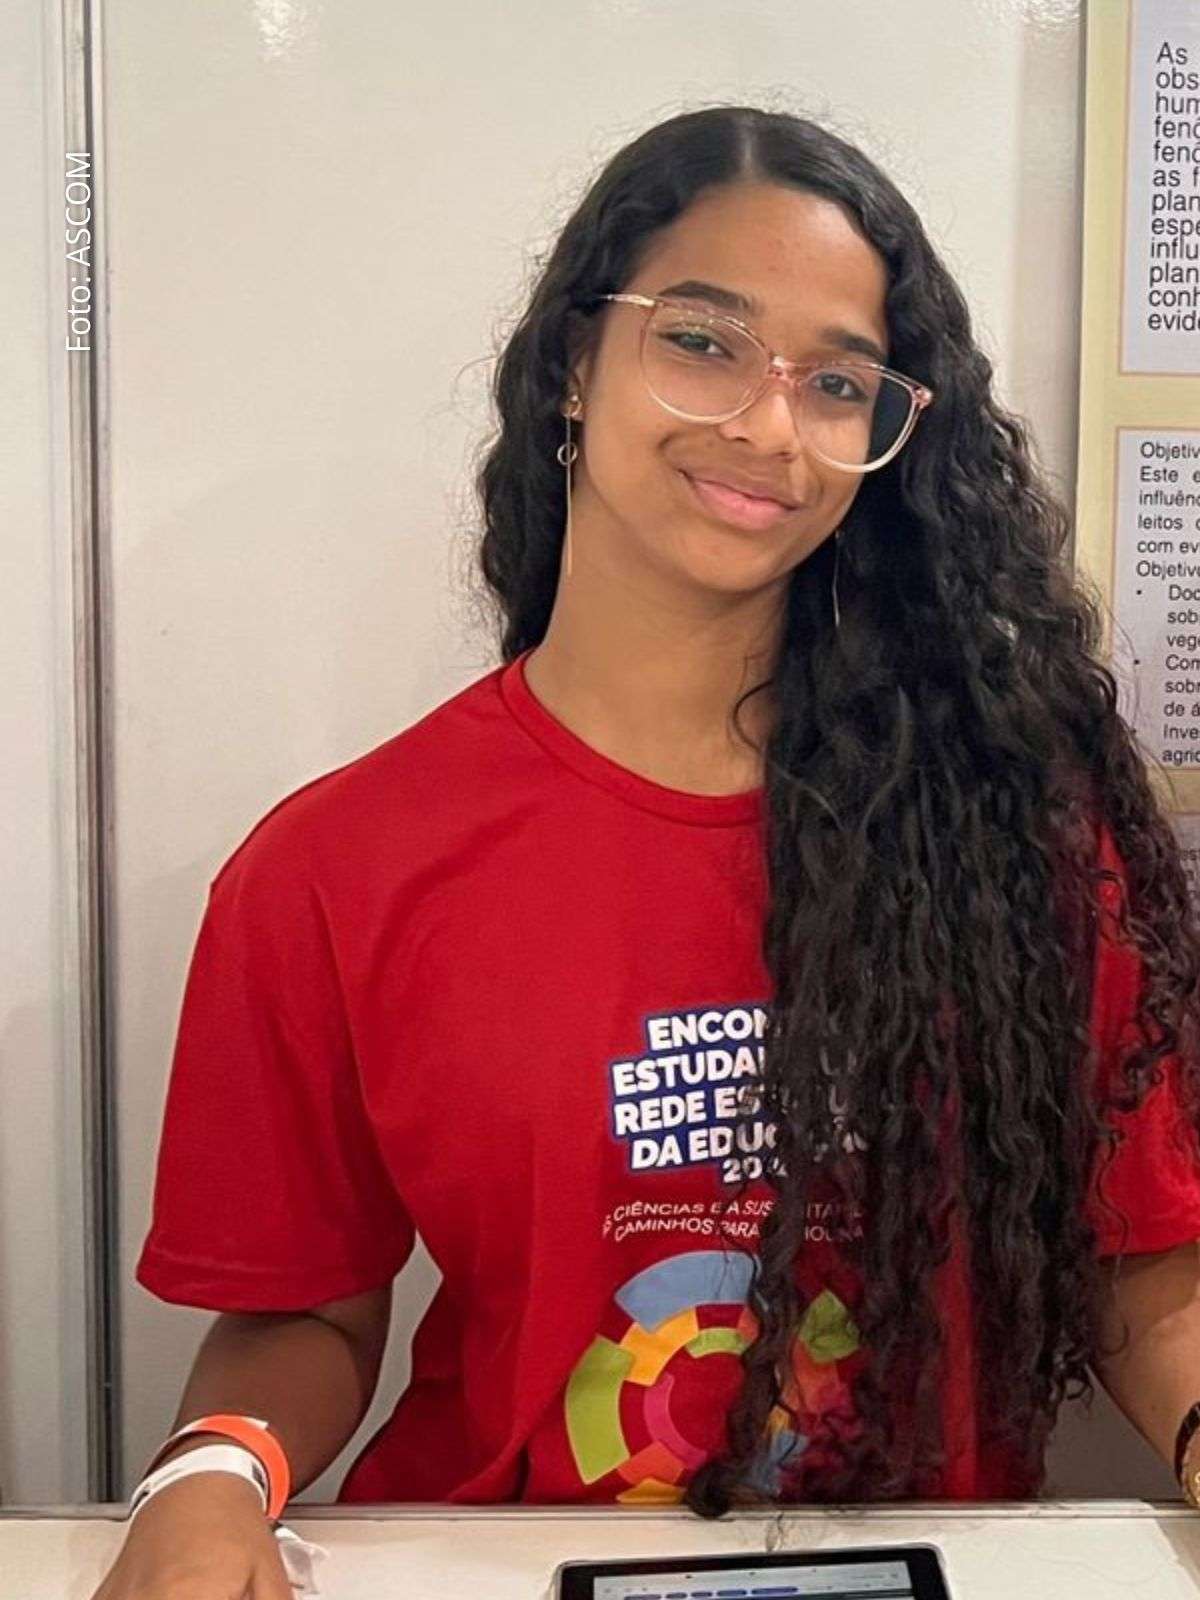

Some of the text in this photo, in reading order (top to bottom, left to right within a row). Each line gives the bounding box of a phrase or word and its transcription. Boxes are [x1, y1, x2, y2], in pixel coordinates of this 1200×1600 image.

[1156, 44, 1188, 65] As
[1140, 466, 1178, 483] Este
[1137, 542, 1174, 554] com
[1164, 700, 1185, 716] de
[612, 1046, 766, 1096] ESTUDA
[614, 1091, 707, 1135] REDE
[631, 1135, 683, 1169] DA
[613, 1201, 704, 1222] CIÊNCIAS
[726, 1201, 740, 1215] A
[615, 1217, 715, 1242] CAMINHOS
